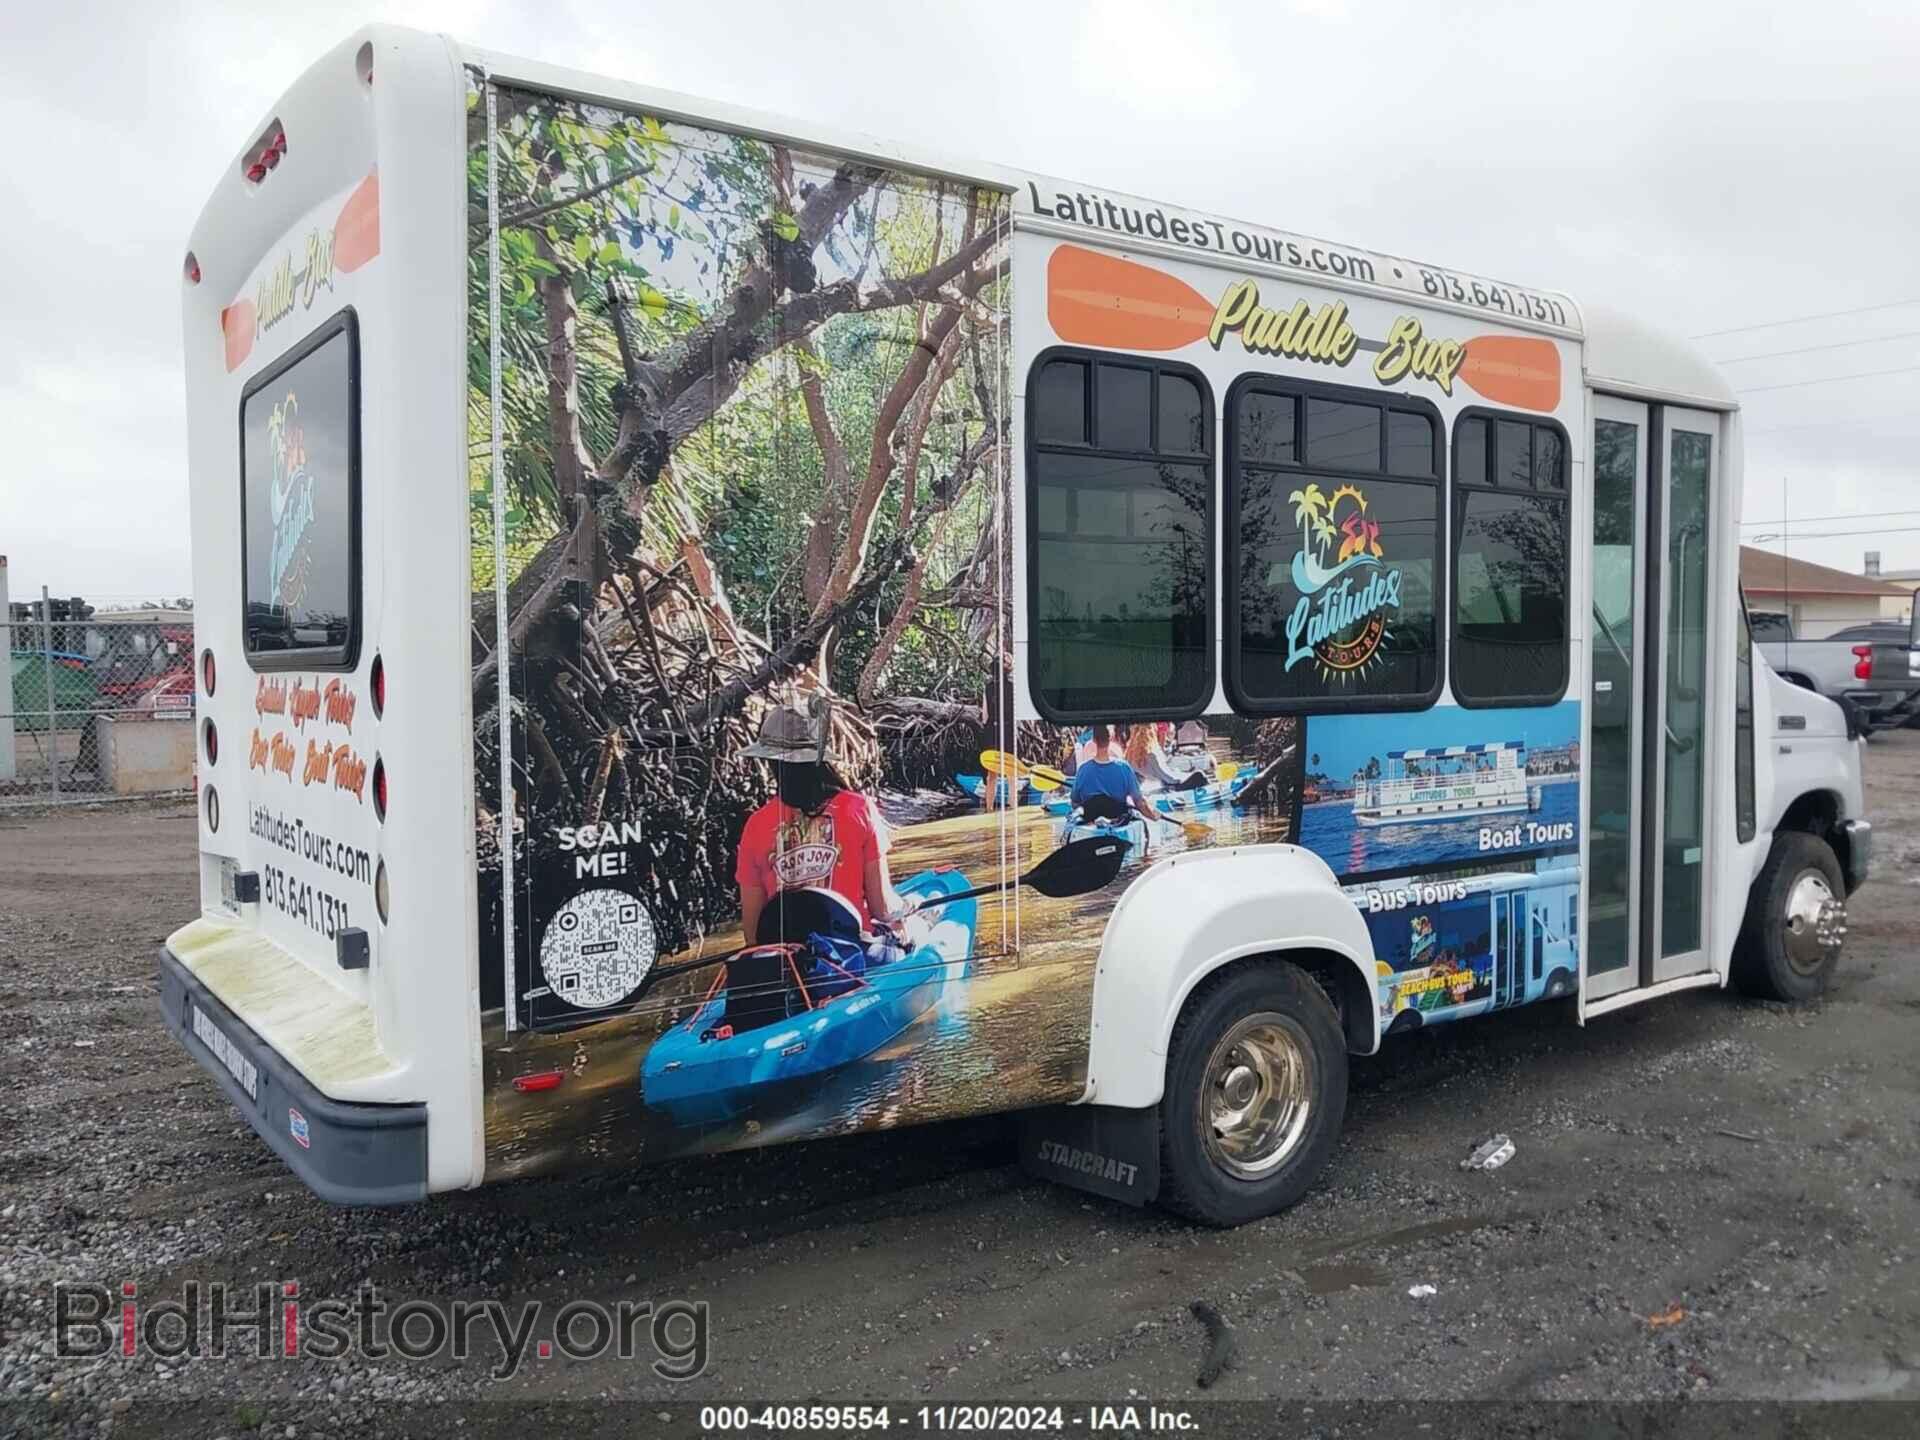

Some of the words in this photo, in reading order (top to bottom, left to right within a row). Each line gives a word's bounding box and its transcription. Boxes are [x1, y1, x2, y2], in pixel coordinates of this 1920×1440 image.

[1027, 181, 1375, 283] LatitudesTours.com
[1420, 268, 1568, 326] 813.641.1311
[1208, 277, 1358, 370] Paddle
[1374, 316, 1467, 396] Bus
[1285, 568, 1403, 673] Latitudes
[249, 799, 371, 885] LatitudesTours.com
[558, 821, 642, 851] SCAN
[806, 850, 832, 864] JON
[1479, 824, 1522, 851] Boat
[1526, 821, 1574, 843] Tours
[576, 852, 628, 879] ME!
[265, 863, 349, 941] 813.641.1311
[1366, 887, 1408, 914] Bus
[1409, 881, 1467, 906] Tours
[1037, 1140, 1138, 1187] STARCRAFT
